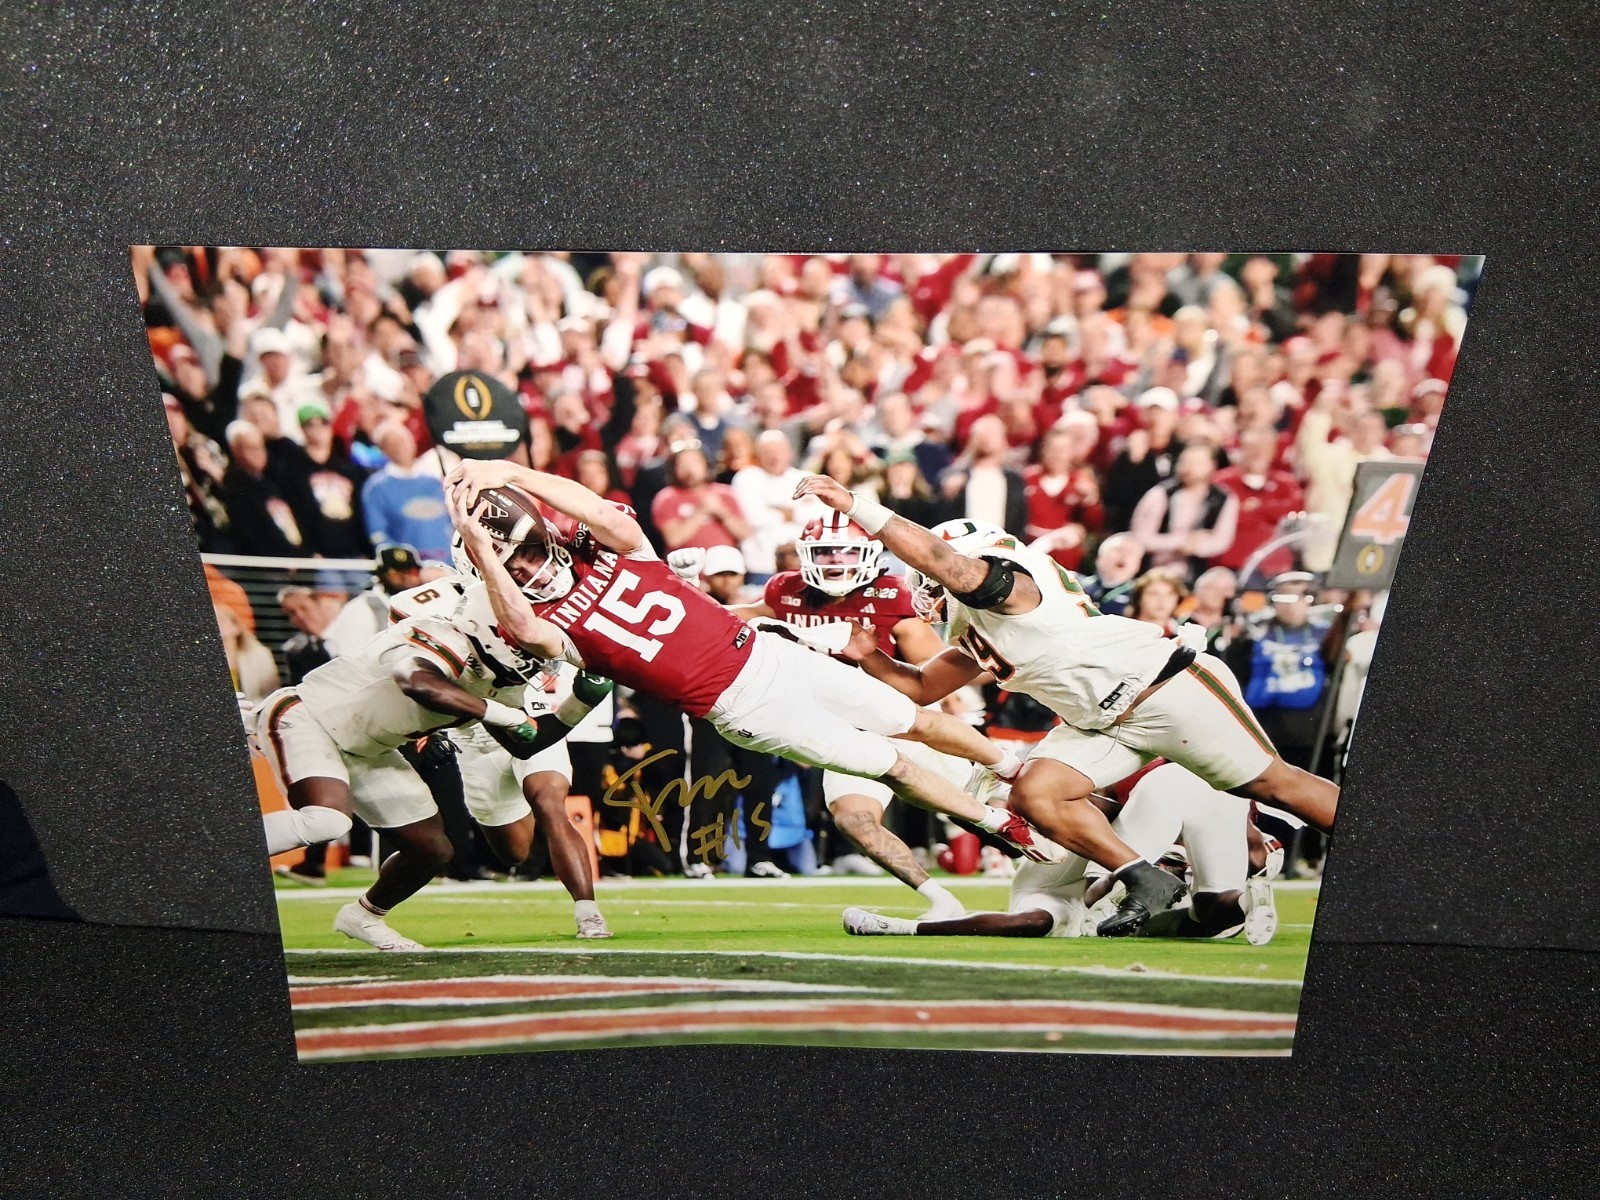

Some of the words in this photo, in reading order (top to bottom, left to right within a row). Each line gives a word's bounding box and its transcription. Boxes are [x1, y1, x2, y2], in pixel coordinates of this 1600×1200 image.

[1350, 472, 1415, 545] 4
[412, 588, 441, 604] 6
[549, 549, 619, 630] INDIANA
[582, 568, 687, 663] 15
[863, 586, 899, 599] 2026
